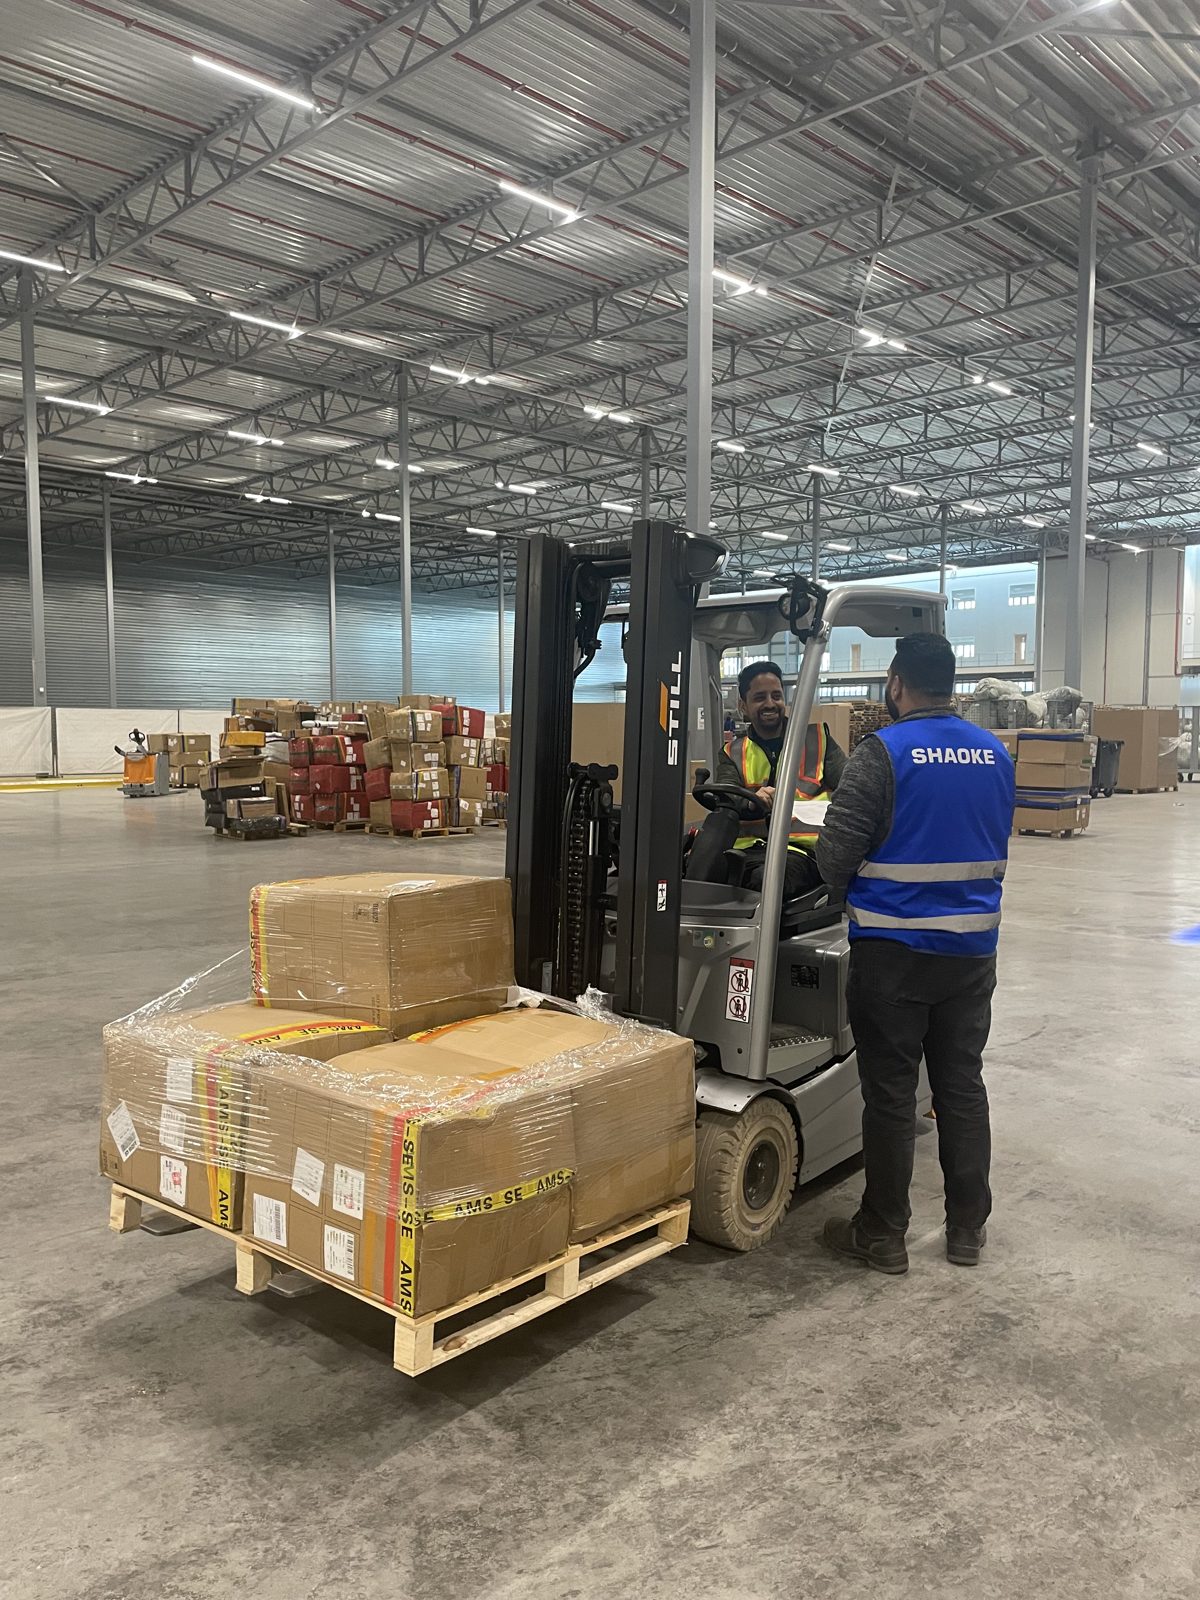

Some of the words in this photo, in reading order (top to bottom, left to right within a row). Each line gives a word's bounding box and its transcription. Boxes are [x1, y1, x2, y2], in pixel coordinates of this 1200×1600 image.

[667, 650, 682, 766] STILL
[911, 747, 996, 765] SHAOKE
[454, 1196, 493, 1216] AMS
[504, 1187, 524, 1205] SE
[400, 1260, 413, 1312] AMS
